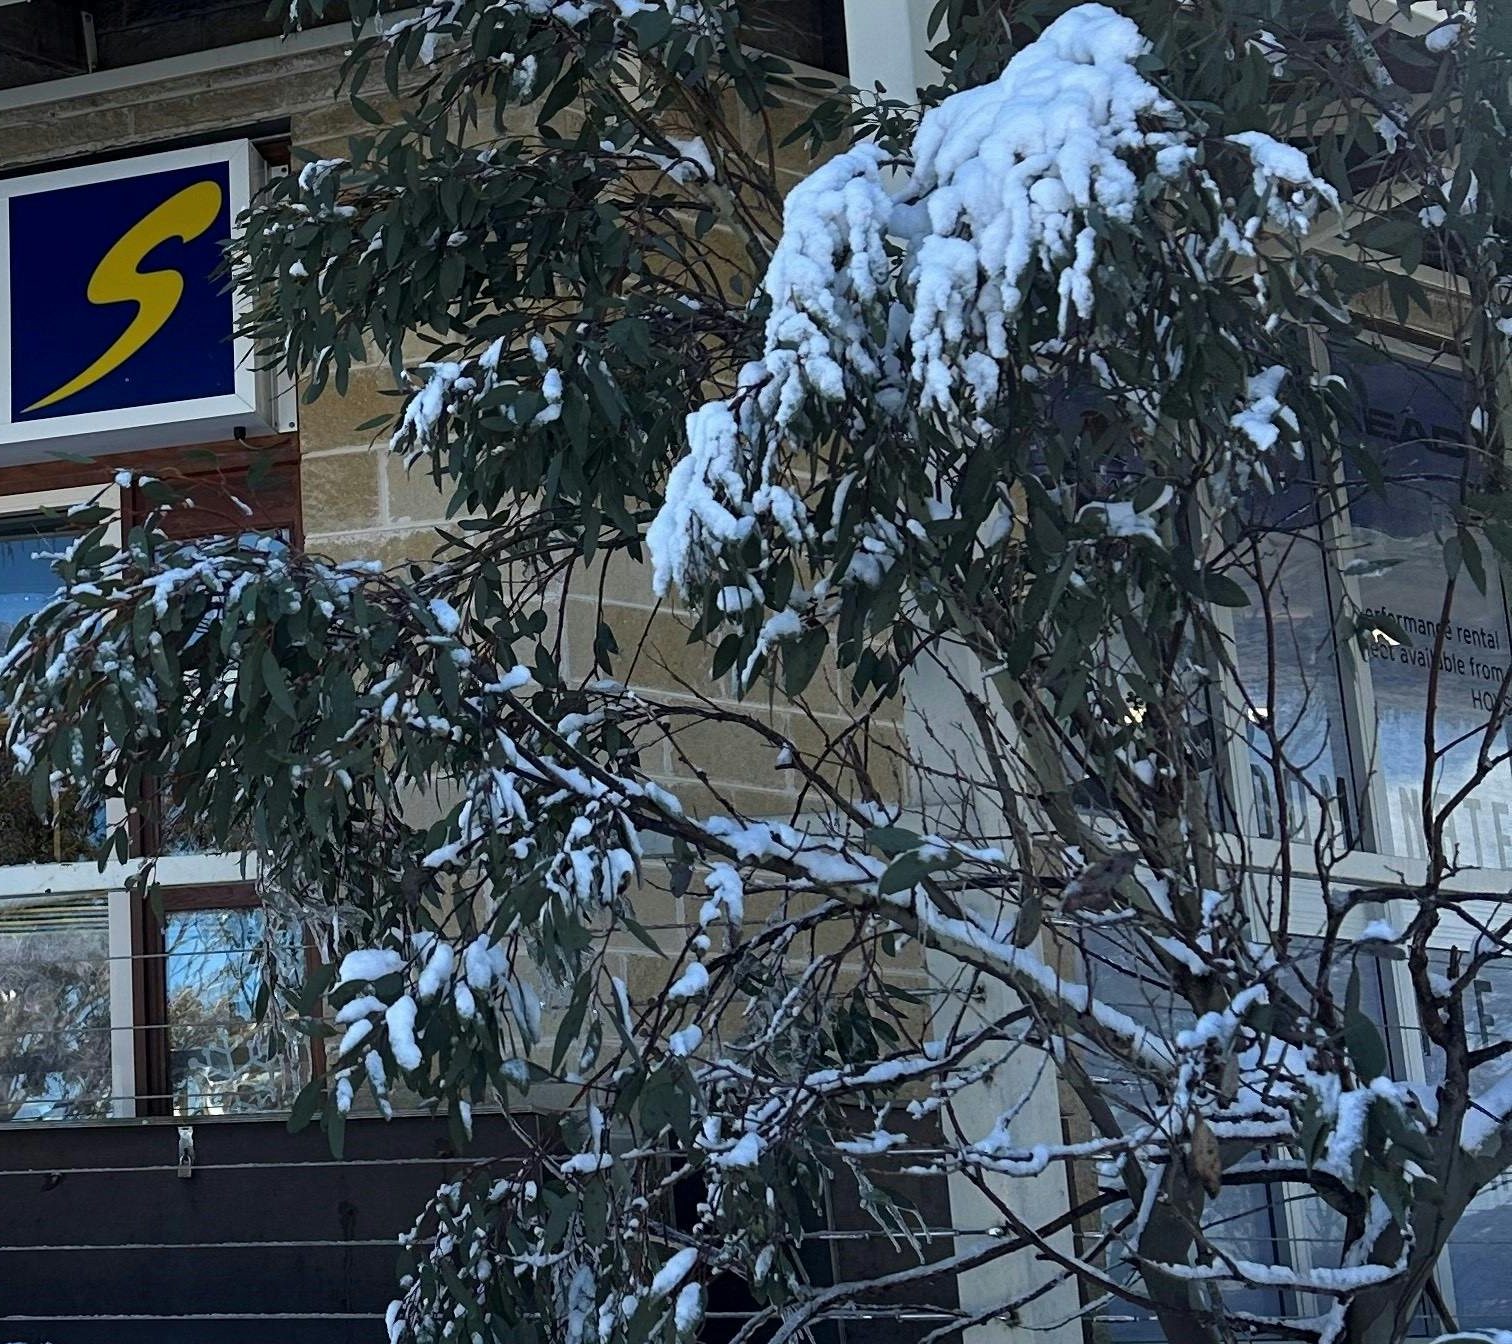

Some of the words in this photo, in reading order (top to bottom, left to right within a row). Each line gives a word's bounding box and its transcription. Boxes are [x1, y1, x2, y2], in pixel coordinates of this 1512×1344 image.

[1367, 407, 1465, 458] EAD
[1364, 606, 1452, 640] ermance
[1457, 627, 1500, 650] rental
[1469, 657, 1504, 682] from
